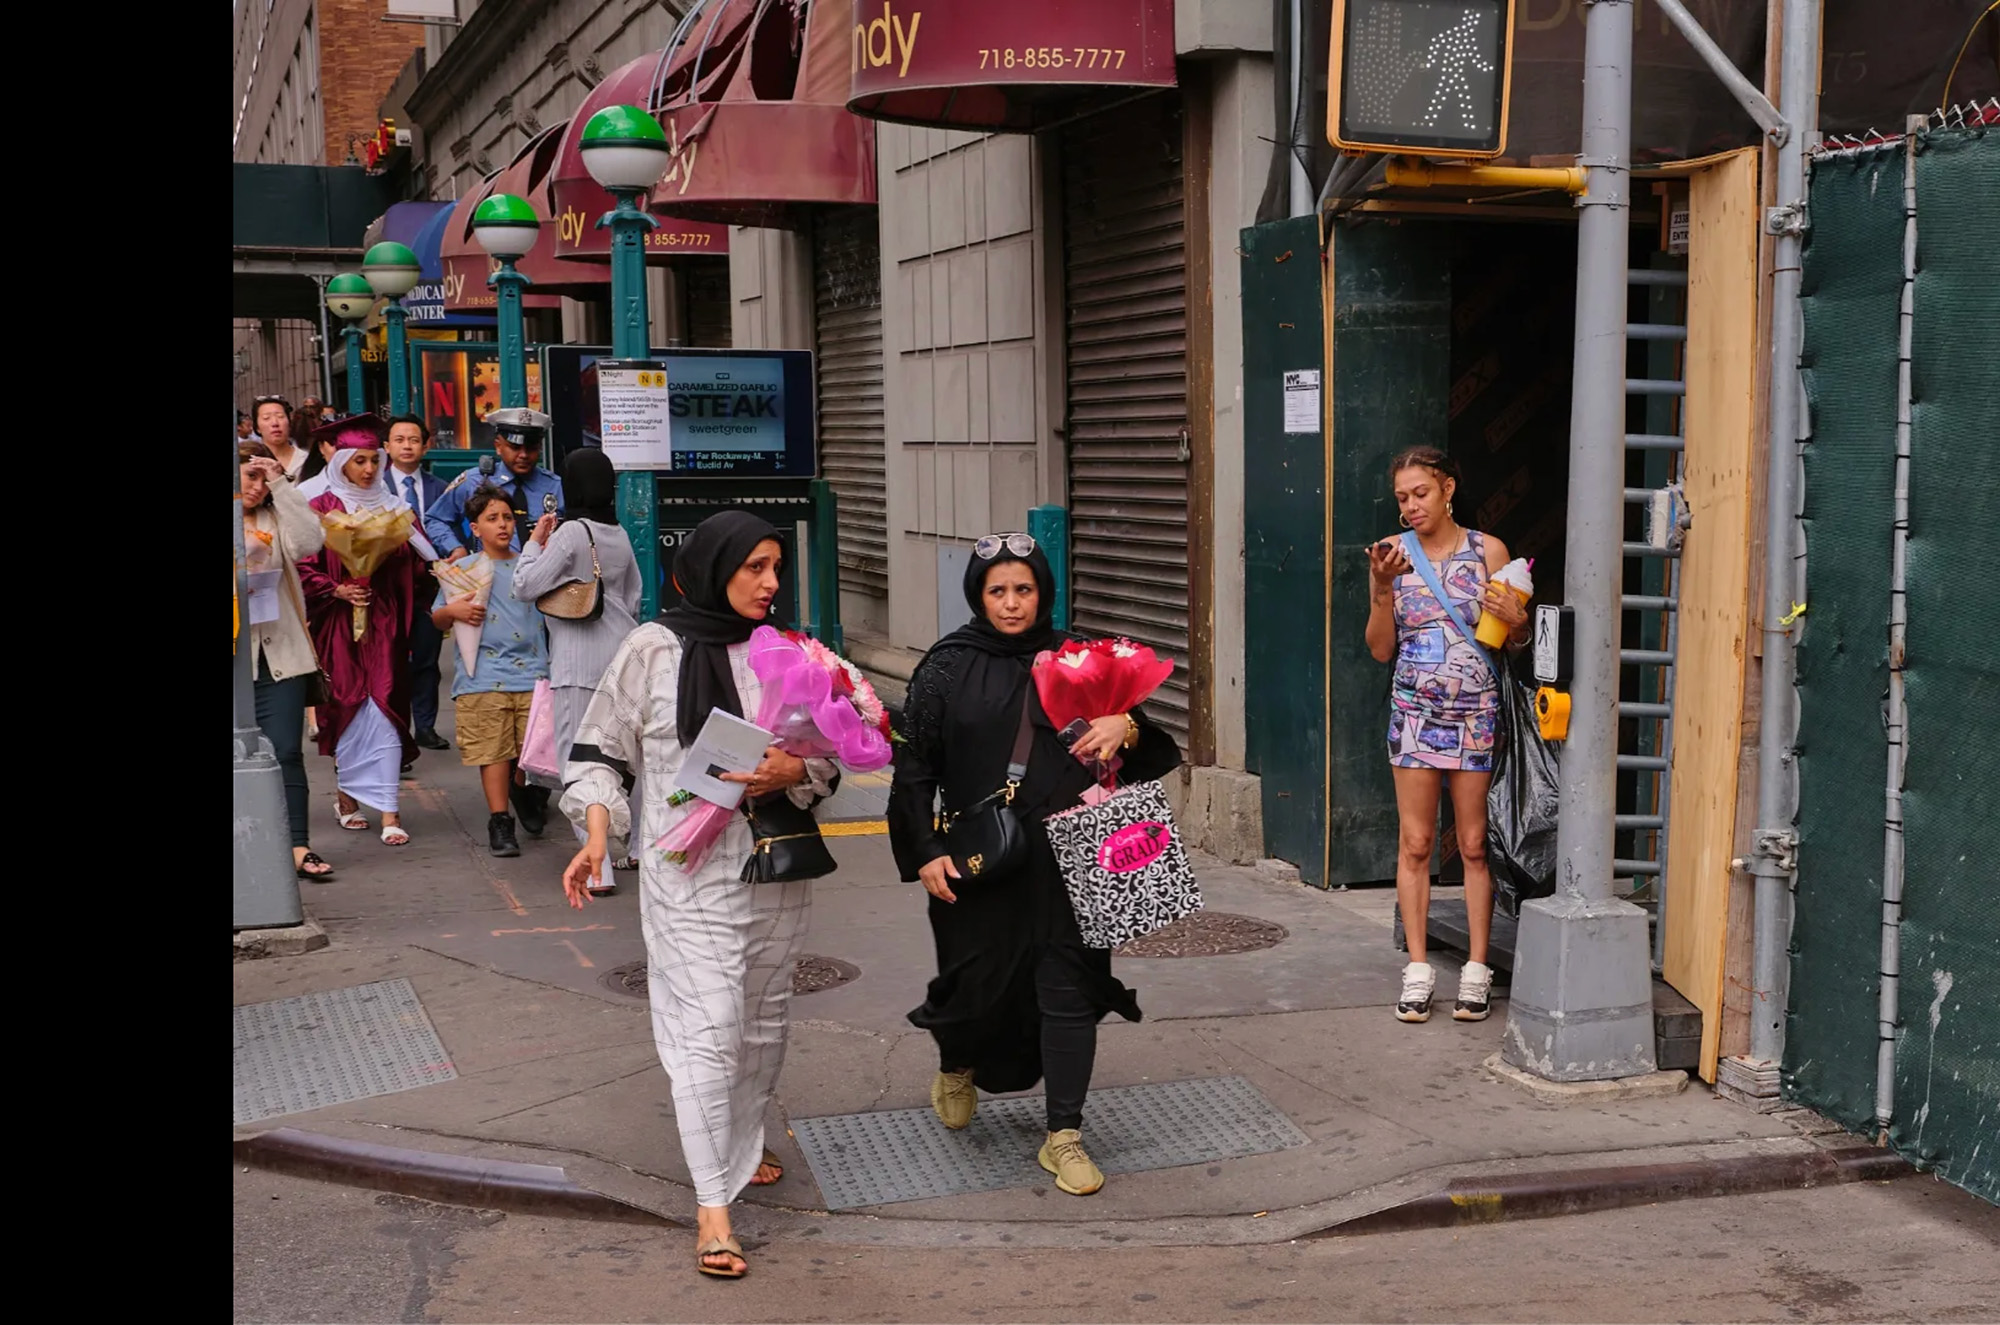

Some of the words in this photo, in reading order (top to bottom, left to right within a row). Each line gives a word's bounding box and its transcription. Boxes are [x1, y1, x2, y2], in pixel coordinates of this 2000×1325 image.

[979, 48, 1126, 70] 718-855-7777
[642, 375, 649, 384] N
[656, 375, 663, 384] R
[668, 383, 739, 392] CARAMELIZED
[740, 383, 778, 392] GARLIC
[433, 382, 455, 417] N
[669, 393, 779, 418] STEAK
[688, 424, 758, 436] sweetgreen
[696, 452, 709, 460] Far
[696, 461, 721, 469] Euclid
[723, 461, 734, 469] Av
[1111, 836, 1160, 869] GRAD
